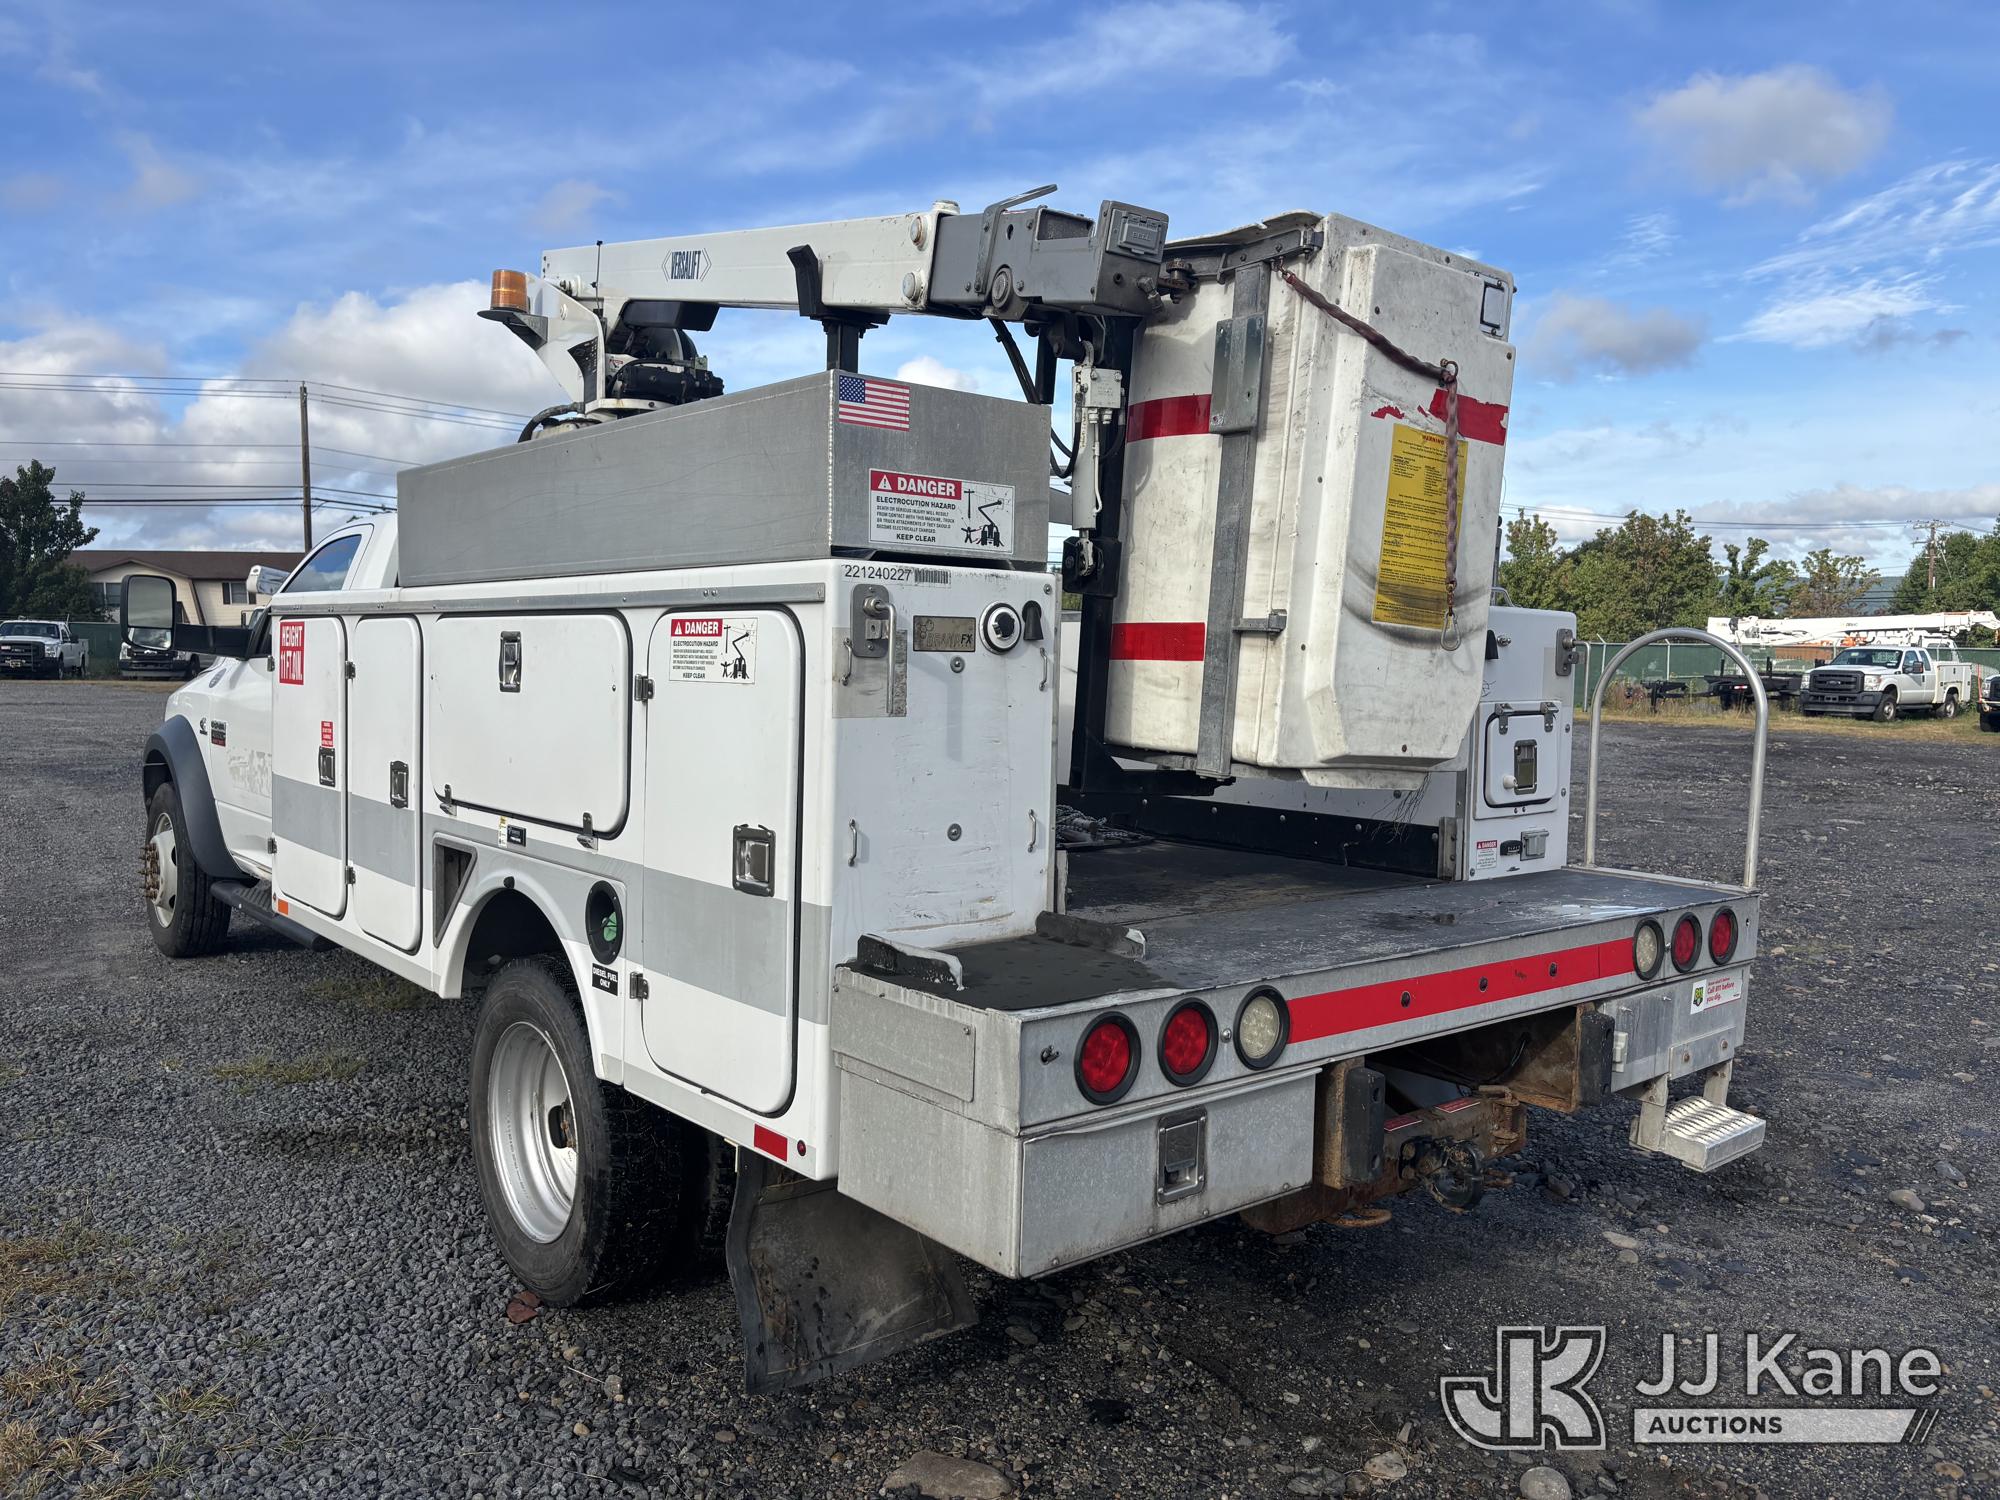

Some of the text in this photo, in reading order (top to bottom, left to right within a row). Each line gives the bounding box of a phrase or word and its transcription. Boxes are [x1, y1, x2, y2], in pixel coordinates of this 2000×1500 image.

[670, 250, 701, 280] VERSALIFT
[897, 477, 956, 496] DANGER
[876, 496, 956, 510] ELECTROCUTION HAZARD
[896, 533, 936, 543] KEEP CLEAR
[844, 564, 912, 581] 221240227
[281, 625, 303, 647] HEIGHT
[684, 621, 719, 635] DANGER
[592, 966, 618, 983] DIESEL FUEL
[599, 978, 611, 988] ONLY
